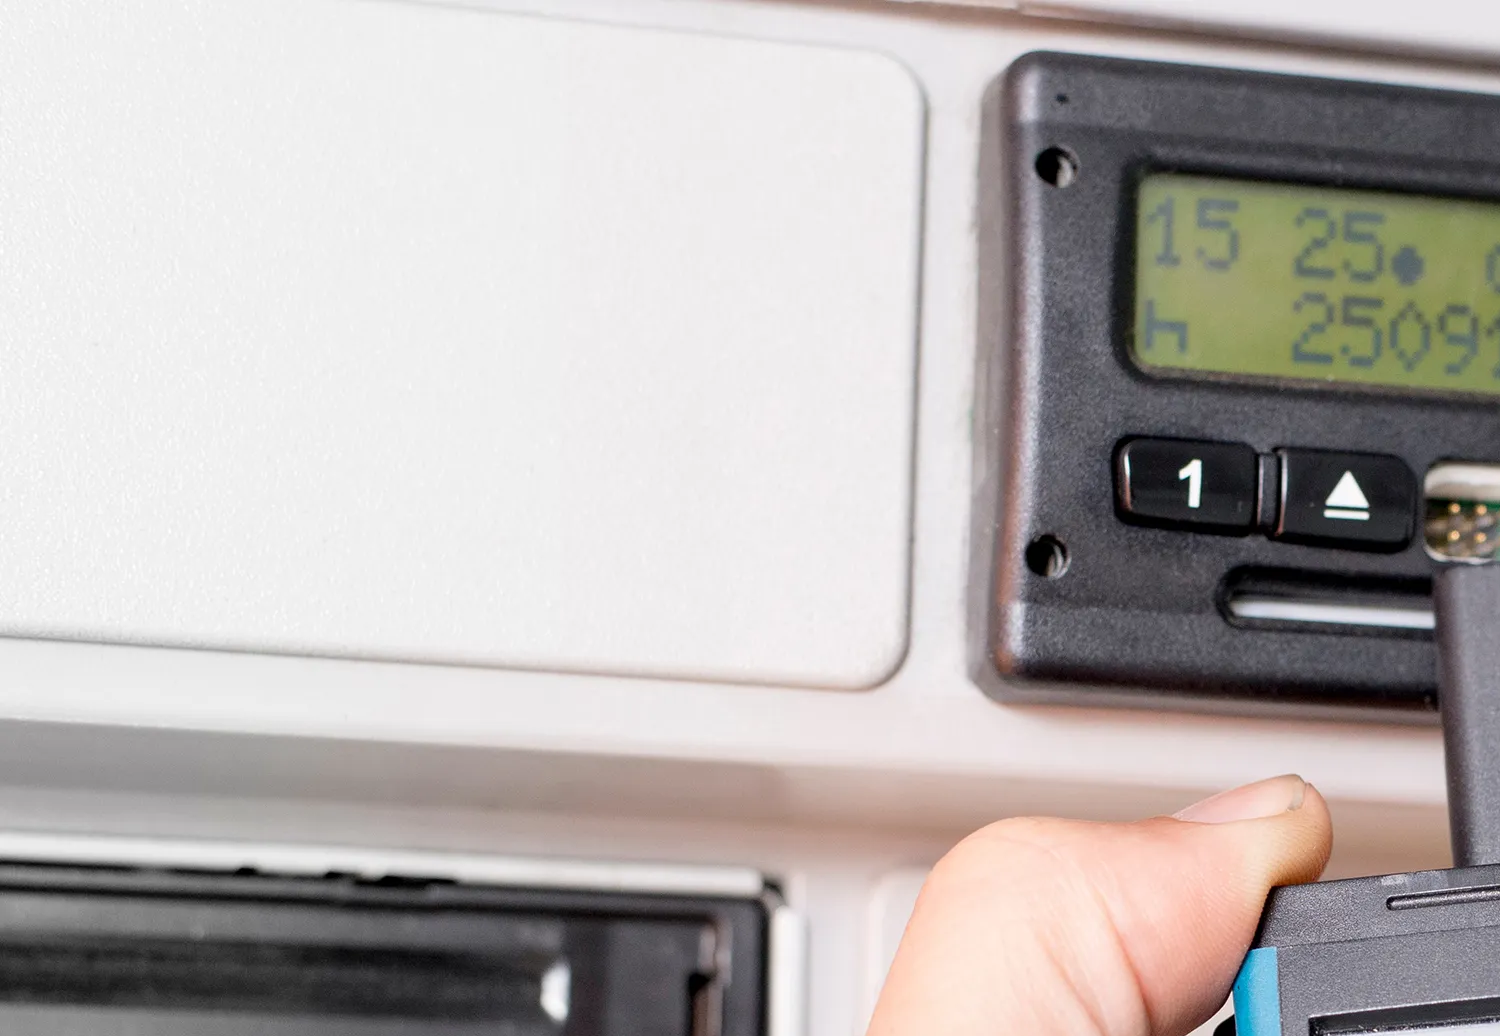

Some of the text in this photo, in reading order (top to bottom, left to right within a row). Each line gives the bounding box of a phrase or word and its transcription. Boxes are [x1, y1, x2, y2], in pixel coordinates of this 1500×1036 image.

[1143, 200, 1240, 270] 15
[1293, 208, 1384, 280] 25
[1177, 458, 1205, 510] 1
